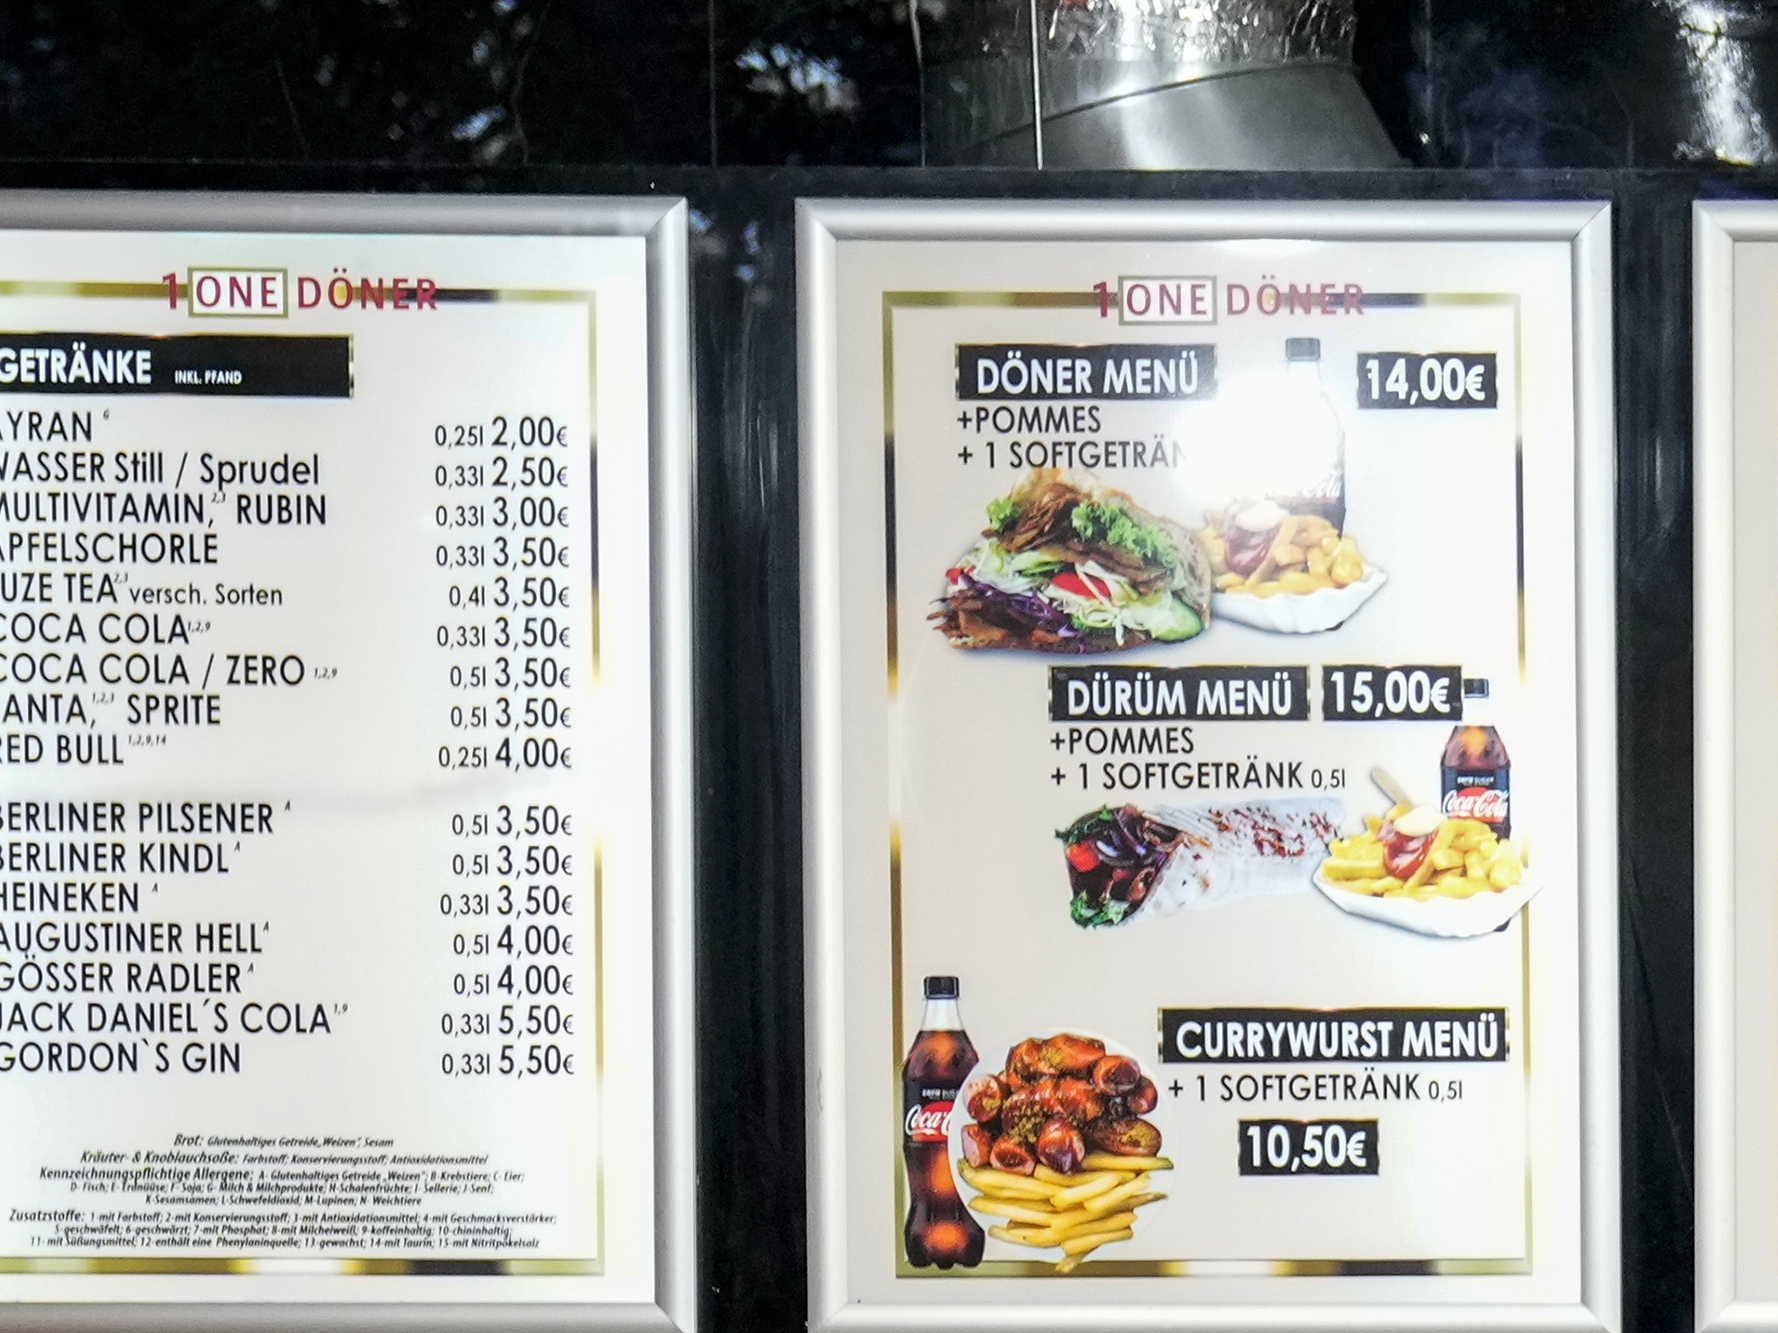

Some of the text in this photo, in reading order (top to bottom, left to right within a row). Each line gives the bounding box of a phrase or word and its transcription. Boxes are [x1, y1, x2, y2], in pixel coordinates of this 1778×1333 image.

[163, 268, 438, 310] 1 ONE DÖNER
[1094, 274, 1364, 317] 1 ONE DÖNER
[0, 341, 242, 385] GETRÄNKE INKL. PFAND
[977, 350, 1199, 395] DÖNER MENÜ
[1365, 357, 1486, 406] 14,00€
[491, 415, 567, 451] 2,00€
[957, 405, 1101, 434] +POMMES
[114, 451, 319, 492] Still Sprudel
[236, 493, 326, 525] RUBIN
[63, 572, 283, 605] TEA versch. Sorten
[98, 612, 190, 645] COLA
[99, 653, 305, 686] COLA ZERO
[127, 693, 221, 725] SPRITE
[1068, 671, 1292, 716] DÜRÜM MENÜ
[1330, 670, 1451, 718] 15,00€
[56, 734, 124, 765] BULL
[495, 737, 572, 772] 4,00€
[1050, 726, 1194, 755] +POMMES
[1102, 755, 1303, 790] SOFTGETRÄNK
[138, 802, 273, 833] PILSENER
[139, 842, 229, 873] KINDL
[196, 923, 263, 953] HELL
[496, 924, 573, 959] 4,00€
[127, 962, 241, 993] RADLER
[240, 1002, 331, 1034] COLA
[498, 1004, 574, 1039] 5,50€
[1176, 1012, 1498, 1058] CURRYWURST MENÜ
[182, 1042, 240, 1073] GIN
[1220, 1066, 1420, 1102] SOFTGETRÄNK
[174, 1134, 202, 1147] Brot:
[1247, 1124, 1367, 1172] 10,50€
[9, 1209, 84, 1222] Zusatzstoffe:
